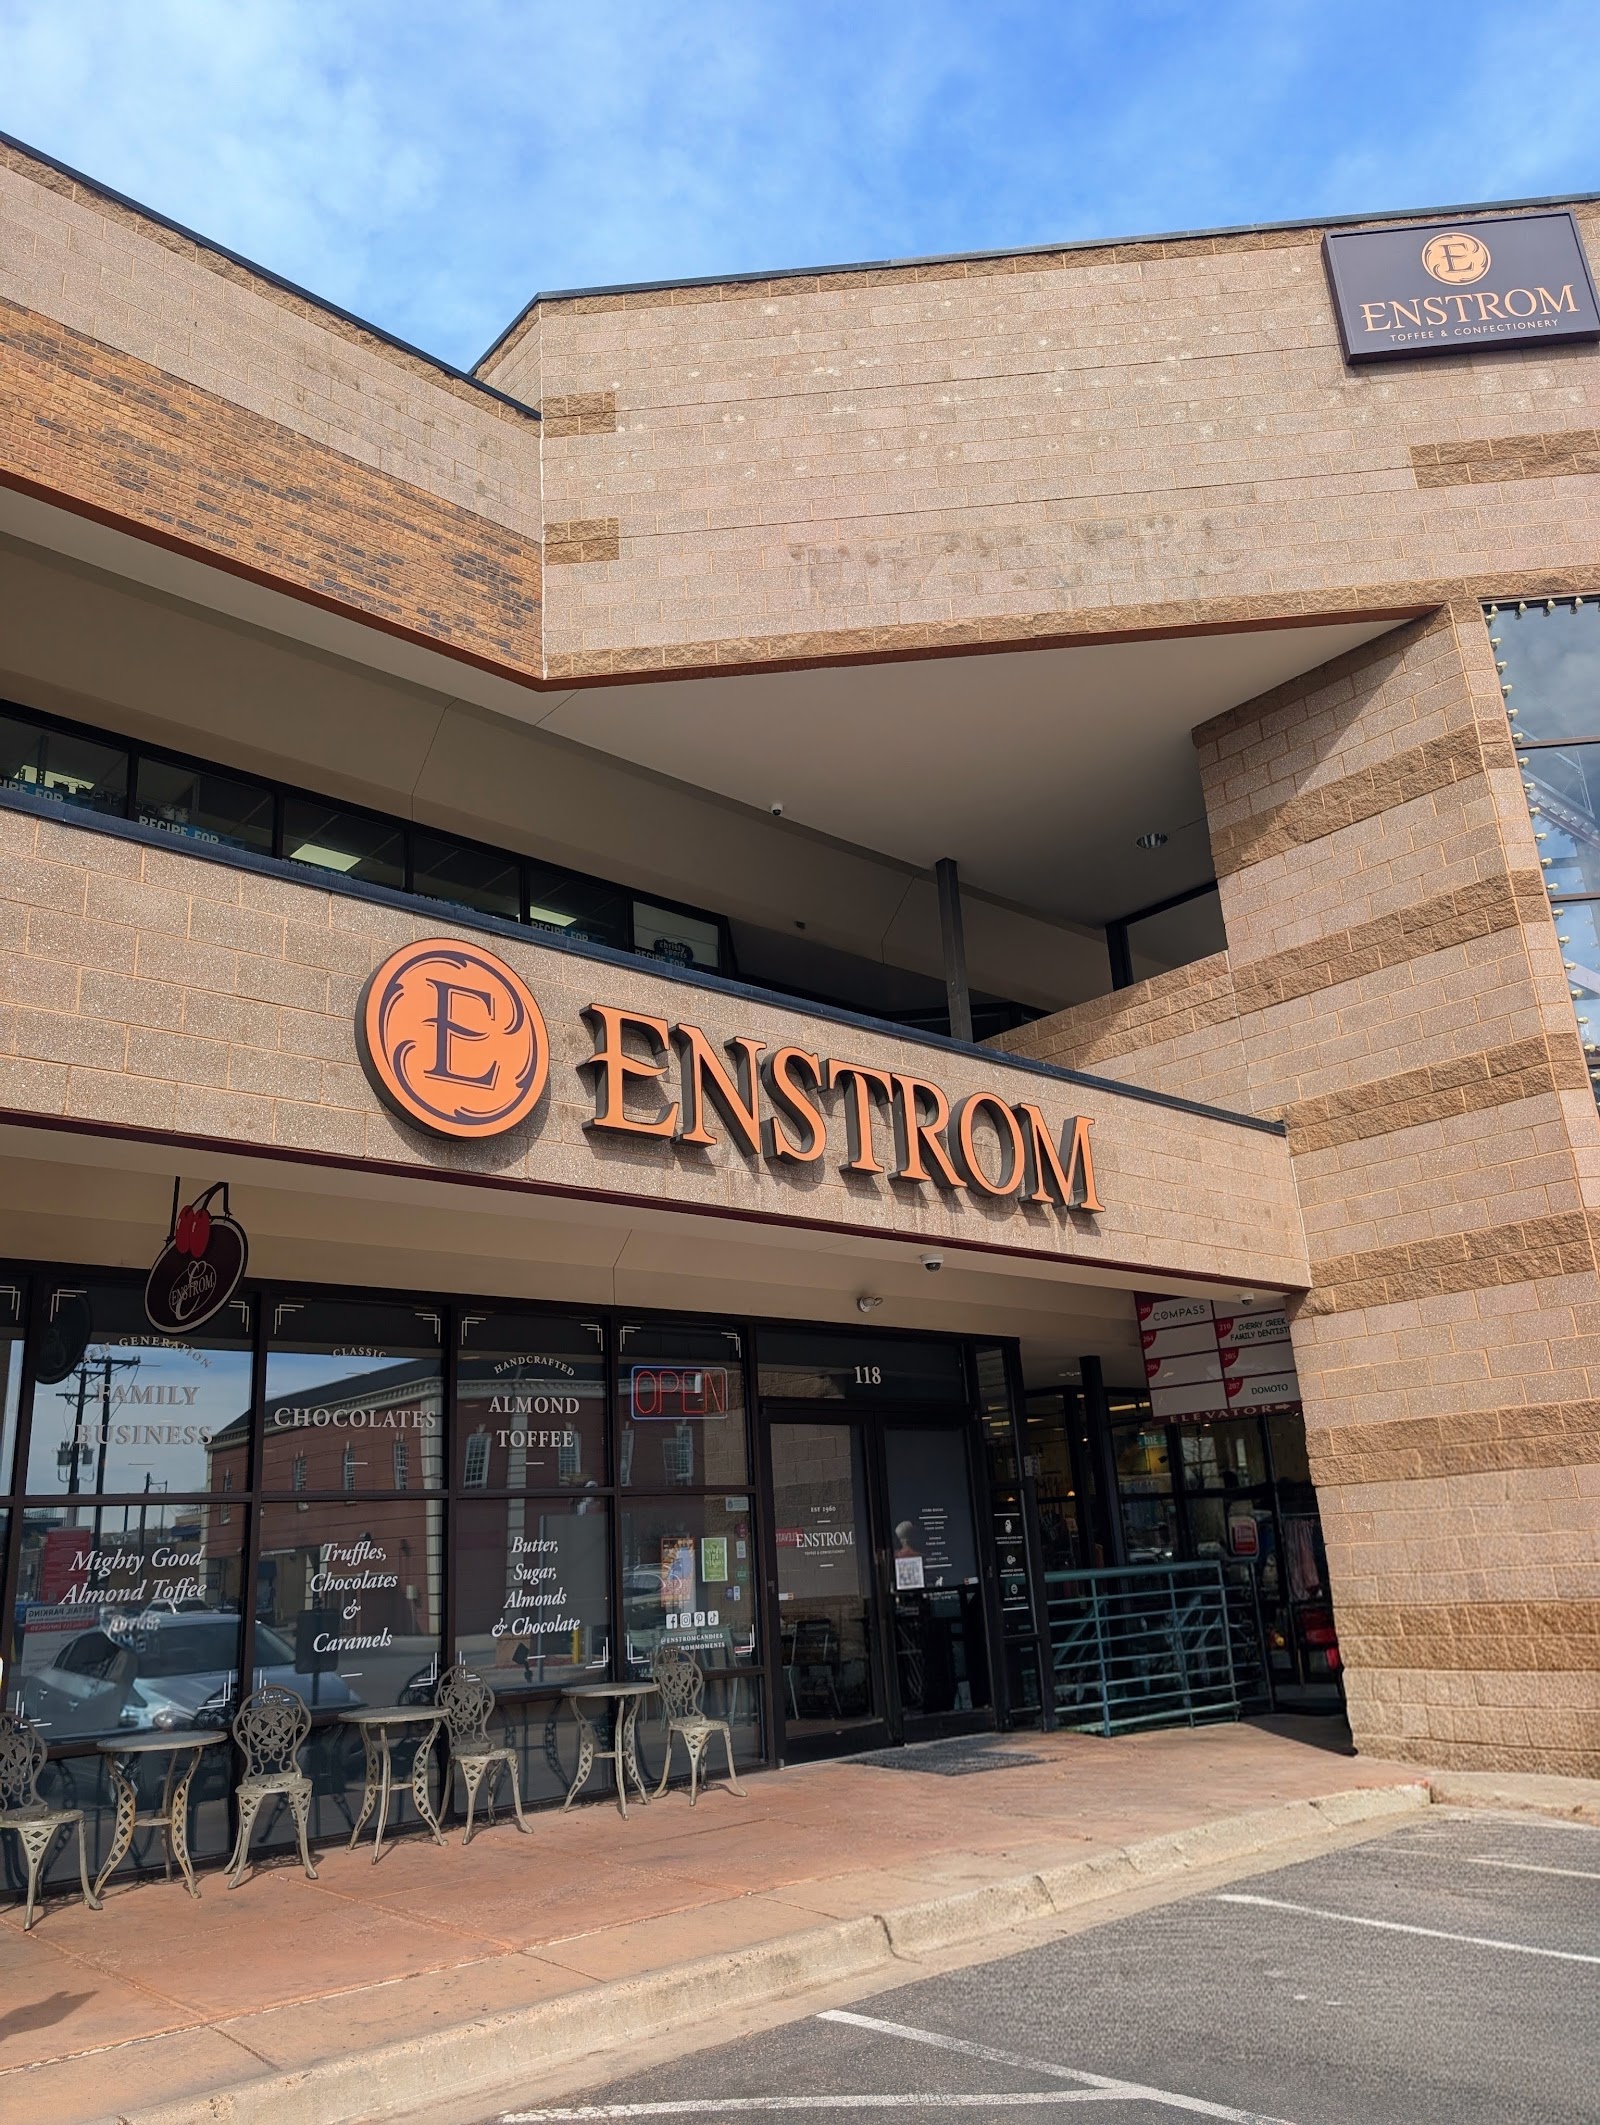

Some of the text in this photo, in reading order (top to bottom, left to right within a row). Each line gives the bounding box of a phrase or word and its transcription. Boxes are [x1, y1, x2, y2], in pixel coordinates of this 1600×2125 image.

[1358, 284, 1580, 332] ENSTROM
[1390, 318, 1559, 342] TOFFEE & CONFECTIONERY
[576, 1002, 1106, 1215] ENSTROM
[171, 1271, 214, 1306] ENSTROM
[1153, 1304, 1206, 1322] COMPASS
[1219, 1317, 1287, 1332] 210 CHERRY CREEK
[1230, 1331, 1256, 1342] FAMILY
[118, 1335, 214, 1369] GENERATION
[332, 1346, 387, 1360] CLASSIC
[493, 1354, 576, 1377] HANDCRAFTED
[853, 1365, 881, 1385] 118
[96, 1382, 201, 1406] FAMILY
[634, 1369, 725, 1414] OPEN
[1228, 1382, 1289, 1396] 207 DOMOTO
[488, 1395, 580, 1415] ALMOND
[1169, 1404, 1272, 1424] ELEVATOR
[274, 1406, 436, 1430] CHOCOLATES
[75, 1423, 214, 1446] BUSINESS
[496, 1429, 574, 1449] TOFFEE
[810, 1505, 837, 1514] EST 1960
[510, 1536, 559, 1554] Butter,
[796, 1531, 854, 1548] ENSTROM
[68, 1544, 206, 1577] Mighty Good
[322, 1540, 388, 1567] Truffles,
[310, 1571, 398, 1593] Chocolates
[513, 1562, 557, 1585] Sugar,
[58, 1576, 208, 1606] Almond Toffee
[503, 1586, 568, 1610] Almonds
[342, 1598, 362, 1620] &
[491, 1616, 581, 1638] & Chocolate
[313, 1626, 393, 1653] Caramels
[660, 1632, 724, 1645] @ENSTROMCANDIES
